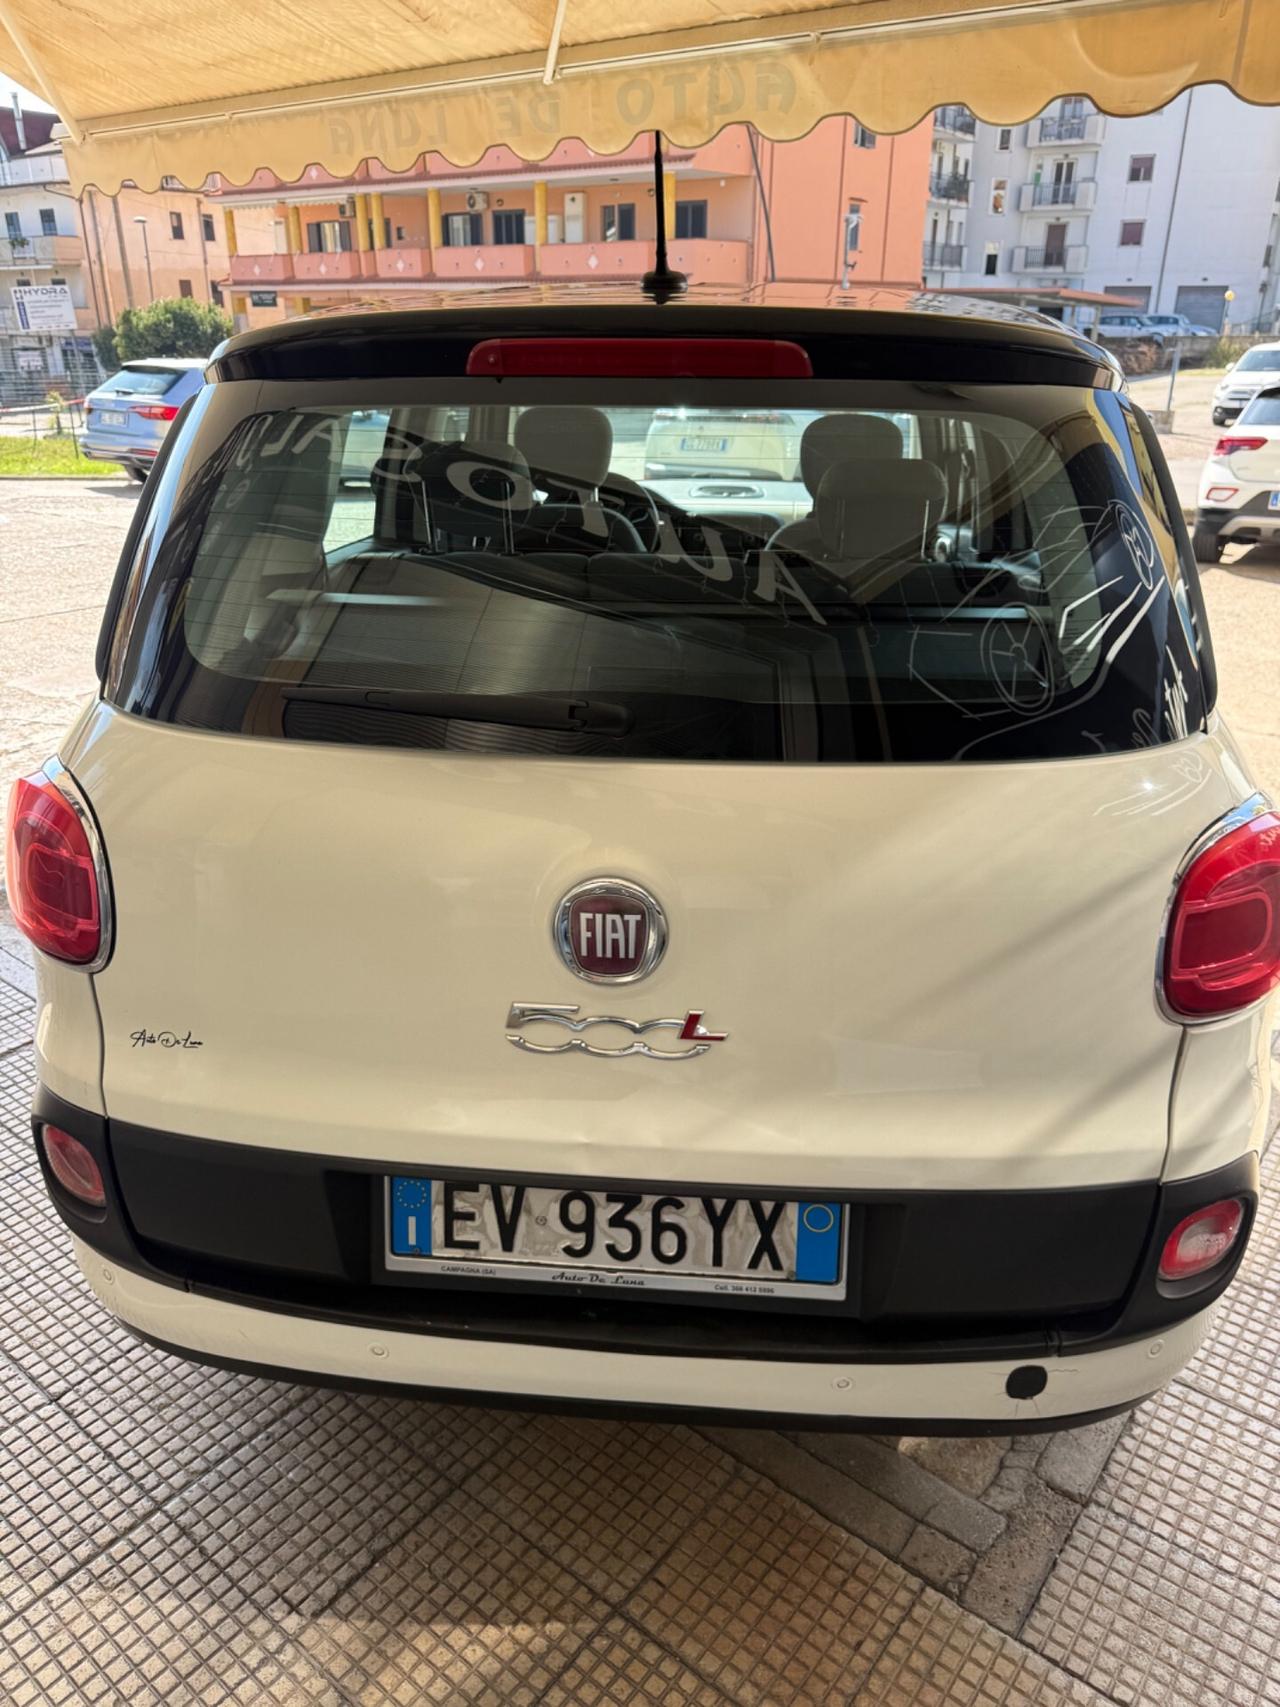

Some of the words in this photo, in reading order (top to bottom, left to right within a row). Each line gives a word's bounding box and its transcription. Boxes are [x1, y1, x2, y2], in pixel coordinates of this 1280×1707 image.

[24, 287, 68, 296] HYDRA
[579, 911, 642, 960] FIAT
[505, 1001, 729, 1061] 500L
[408, 1215, 417, 1246] I
[551, 1271, 588, 1282] Auto
[588, 1273, 606, 1284] De
[610, 1275, 646, 1286] Luna
